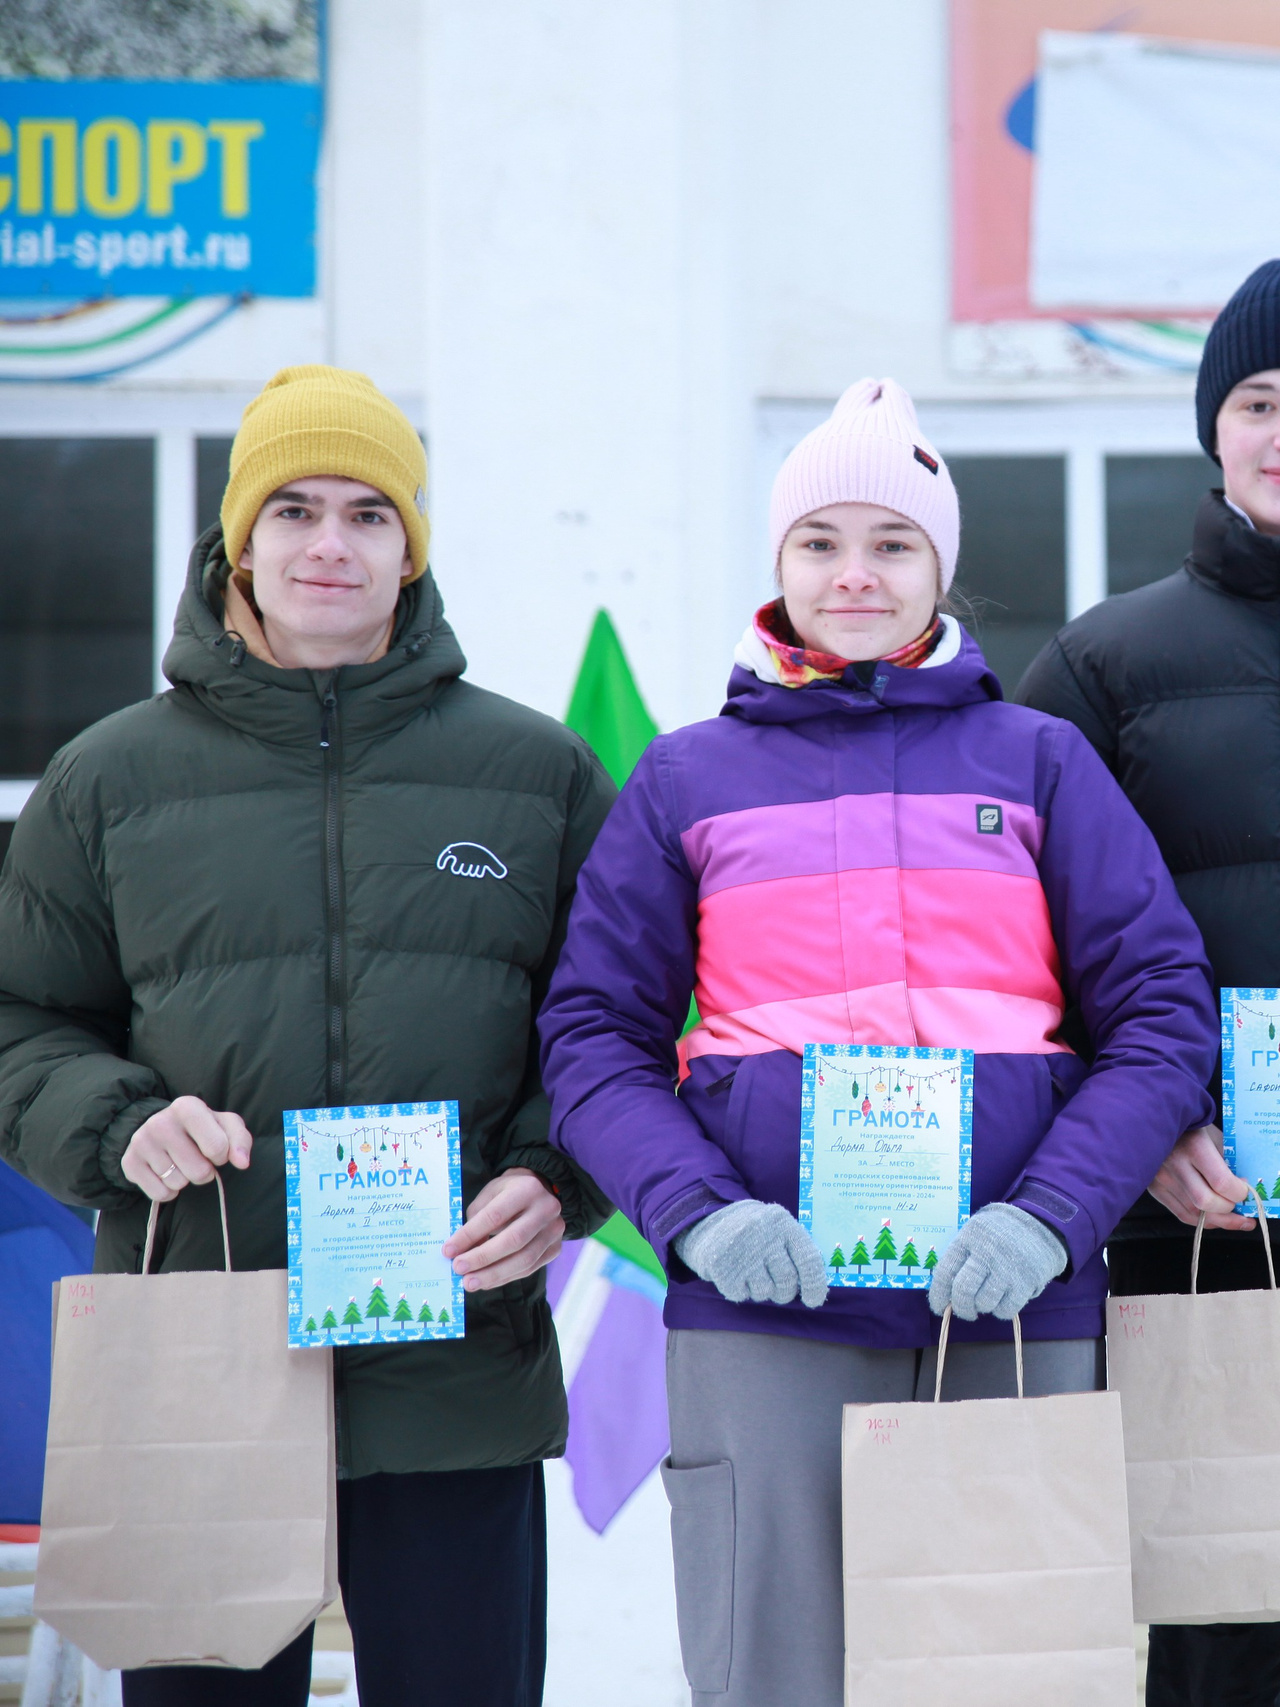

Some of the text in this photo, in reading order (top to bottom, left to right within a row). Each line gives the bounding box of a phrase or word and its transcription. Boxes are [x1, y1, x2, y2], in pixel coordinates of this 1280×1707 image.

[0, 116, 264, 218] ПОРТ
[832, 1110, 941, 1129] ГРАМОТА
[860, 1132, 915, 1140] Награждается
[319, 1168, 428, 1190] ГРАМОТА
[886, 1184, 953, 1192] ориентированию
[348, 1193, 403, 1201] Награждается
[329, 1235, 370, 1243] городских
[371, 1231, 431, 1240] соревнованиях
[322, 1244, 374, 1252] спортивному
[376, 1239, 445, 1248] ориентированию
[355, 1265, 382, 1273] группе
[405, 1281, 439, 1289] 29.12.2024
